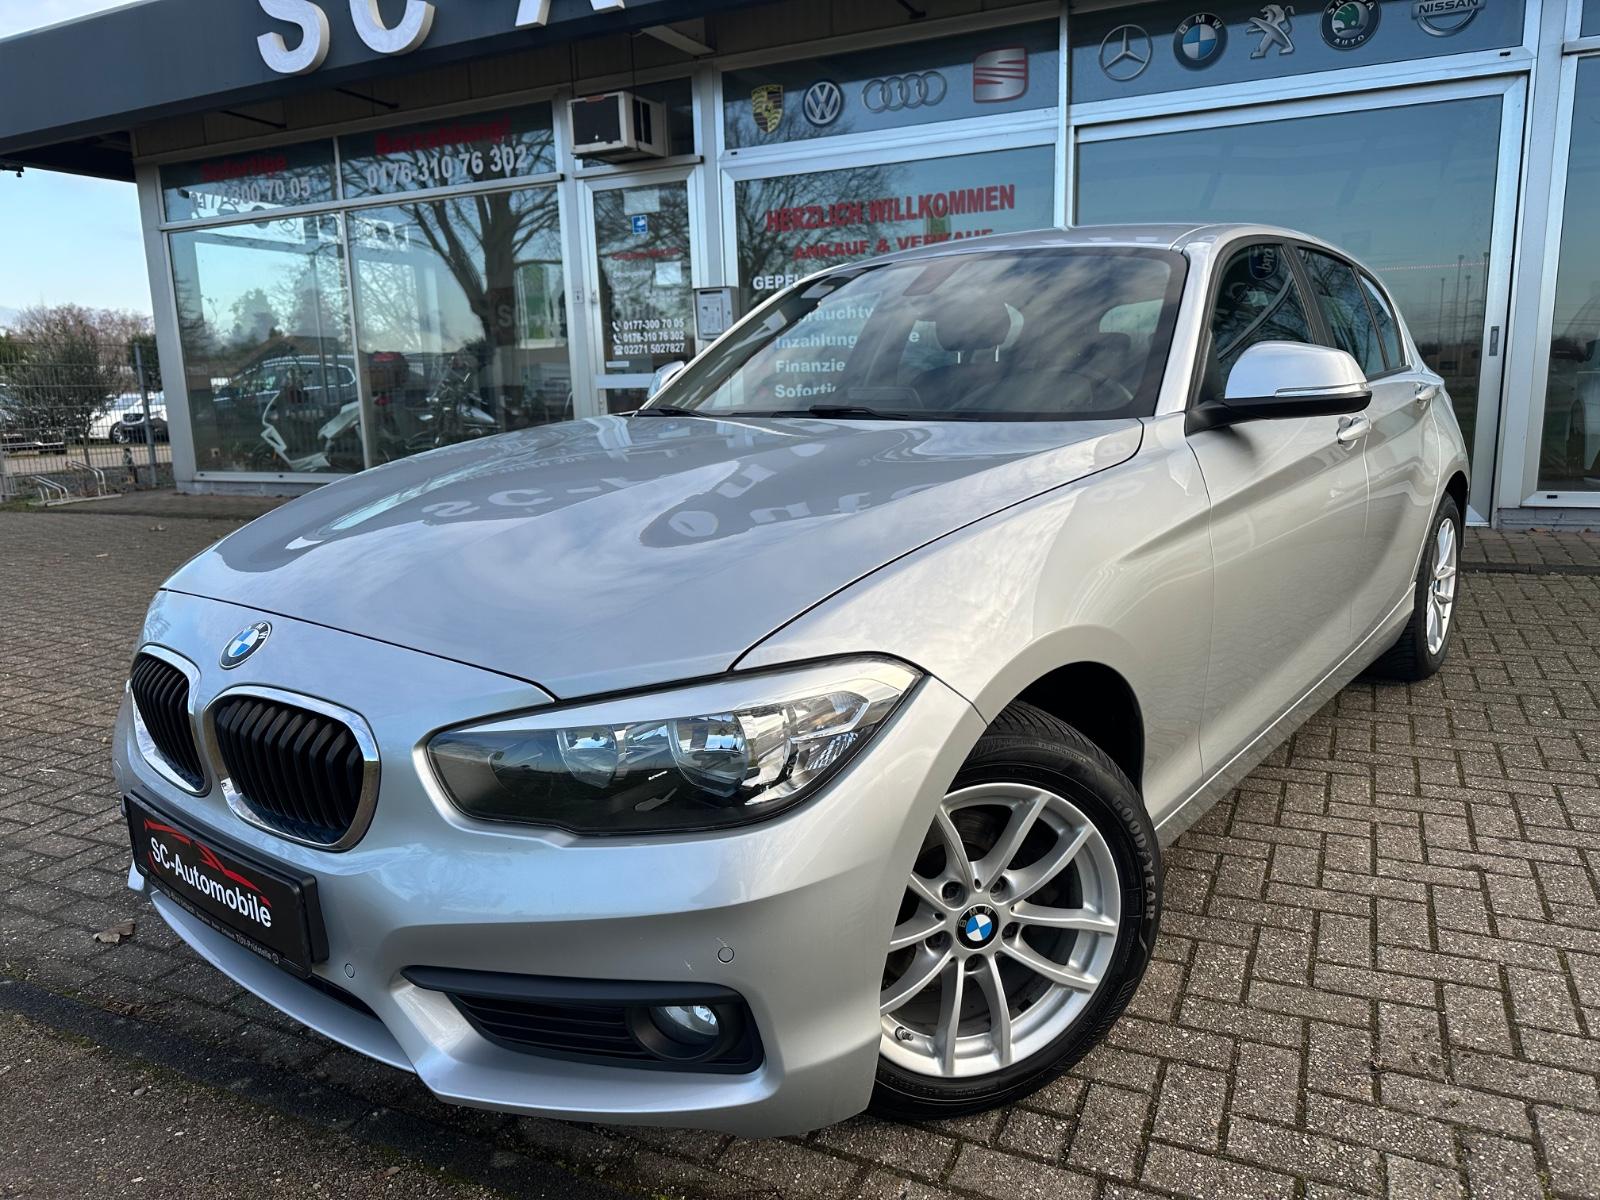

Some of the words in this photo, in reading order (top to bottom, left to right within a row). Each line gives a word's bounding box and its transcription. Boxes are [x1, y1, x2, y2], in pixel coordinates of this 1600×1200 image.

[1417, 0, 1480, 14] NISSAN
[1178, 14, 1223, 34] BMW
[1333, 34, 1365, 46] AUTO
[367, 156, 453, 188] 0176-310
[458, 151, 484, 175] 76
[489, 144, 528, 173] 302
[267, 179, 286, 201] 70
[290, 176, 312, 199] 05
[766, 201, 863, 233] HERZLICH
[869, 184, 1016, 224] WILLKOMMEN
[793, 241, 871, 262] ANKAUF
[876, 237, 890, 254] &
[623, 320, 660, 330] 0177-300
[661, 319, 672, 329] 70
[659, 331, 669, 341] 76
[670, 330, 685, 341] 302
[623, 344, 648, 355] 02271
[650, 342, 686, 354] 5027827
[150, 836, 273, 928] SC-Automobile
